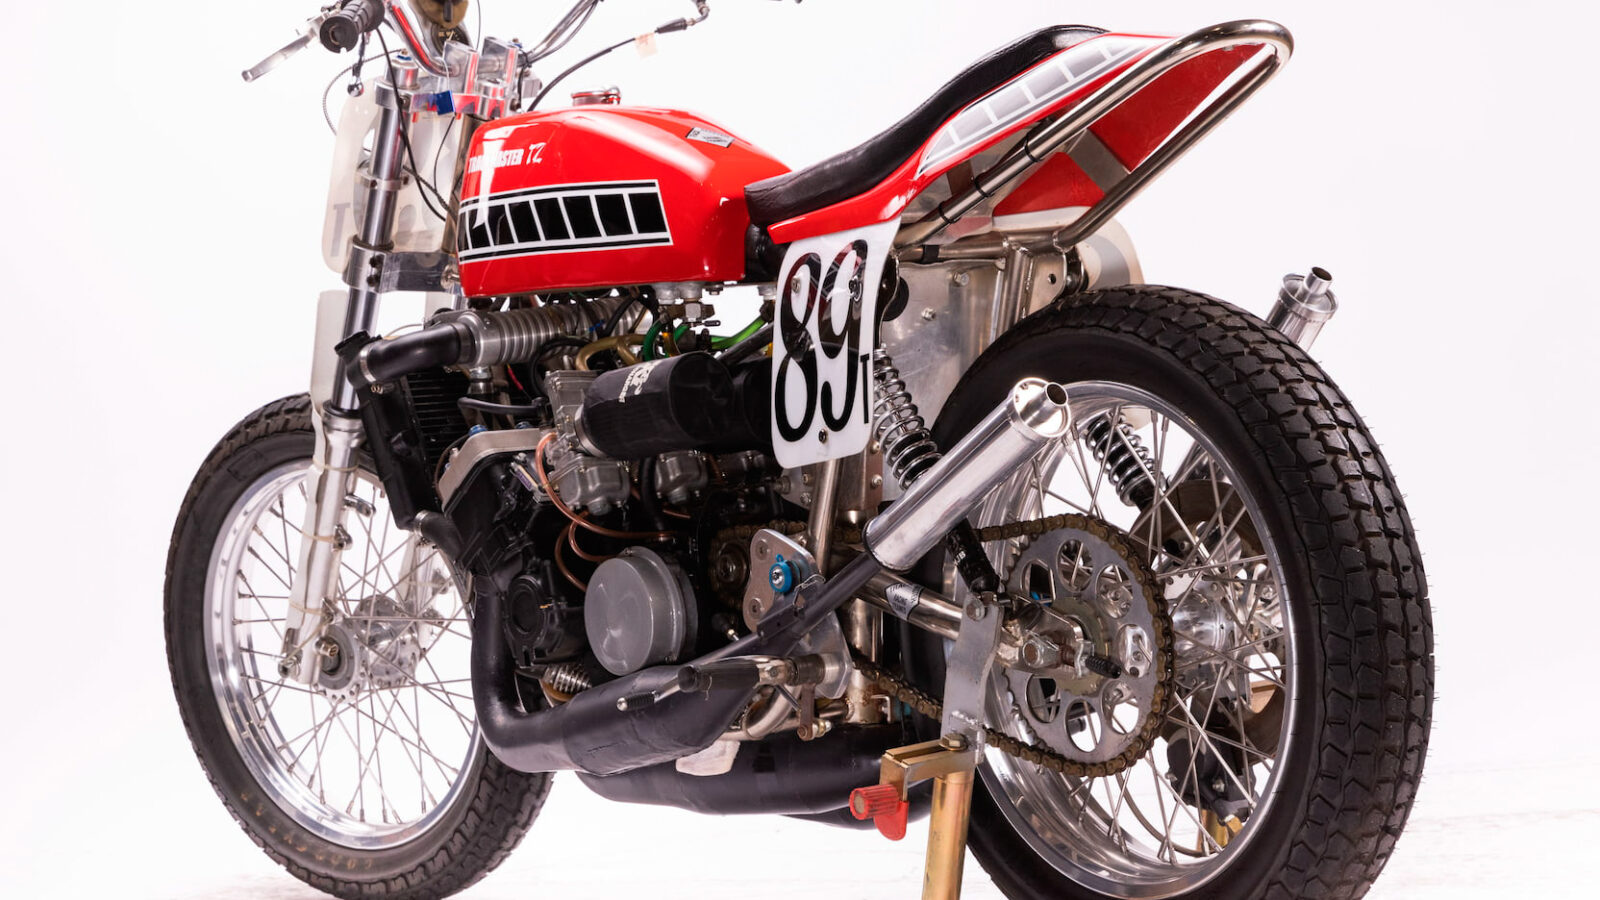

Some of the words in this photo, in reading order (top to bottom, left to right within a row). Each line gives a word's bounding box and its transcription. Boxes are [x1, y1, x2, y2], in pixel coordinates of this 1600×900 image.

[526, 142, 547, 165] TZ
[775, 239, 868, 442] 89
[860, 353, 870, 424] T
